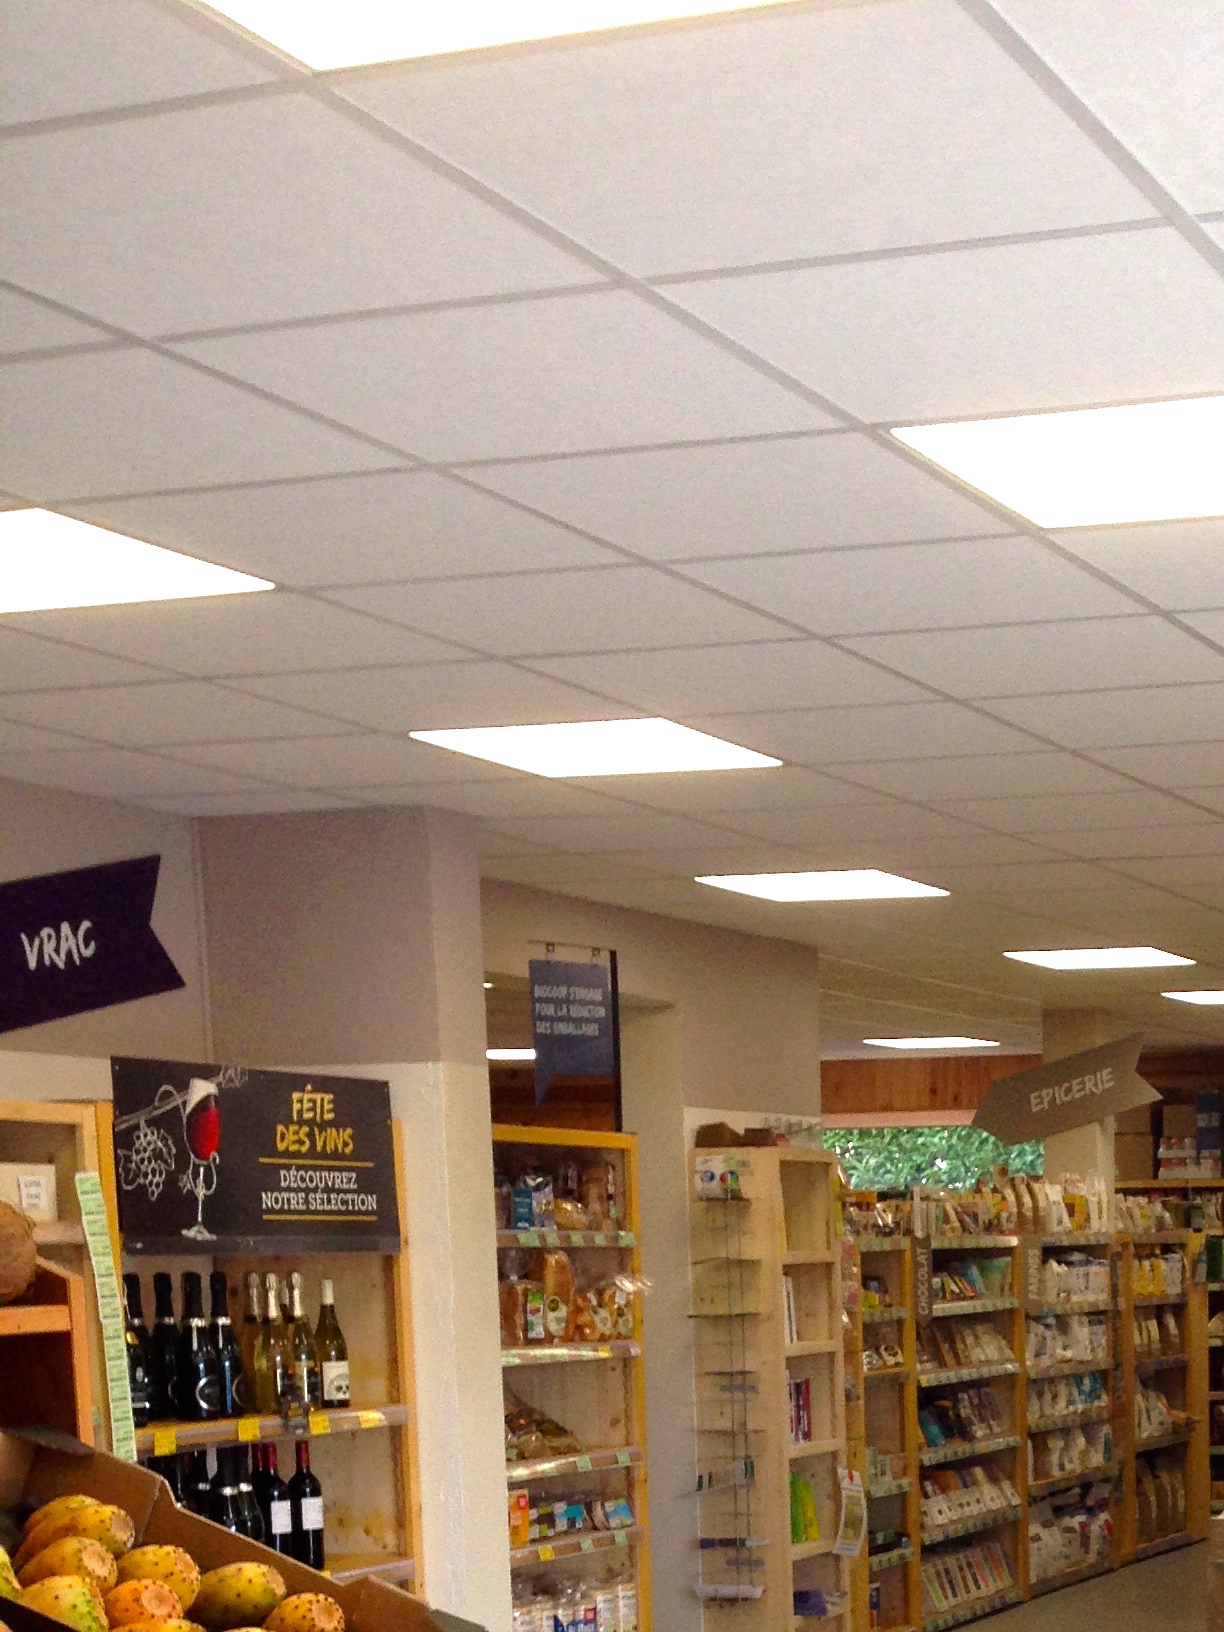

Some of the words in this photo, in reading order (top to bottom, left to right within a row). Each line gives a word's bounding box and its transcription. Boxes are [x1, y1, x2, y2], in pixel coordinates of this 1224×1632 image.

[20, 920, 97, 971] VRAC
[292, 1084, 335, 1122] FÊTE
[1029, 1068, 1115, 1113] EPICERIE
[276, 1124, 309, 1152] DES
[315, 1125, 354, 1154] VINS
[280, 1166, 357, 1189] DÉCOUVREZ
[261, 1192, 309, 1210] NOTRE
[309, 1189, 377, 1212] SÉLECTION
[916, 1247, 929, 1315] CHOCOLAT
